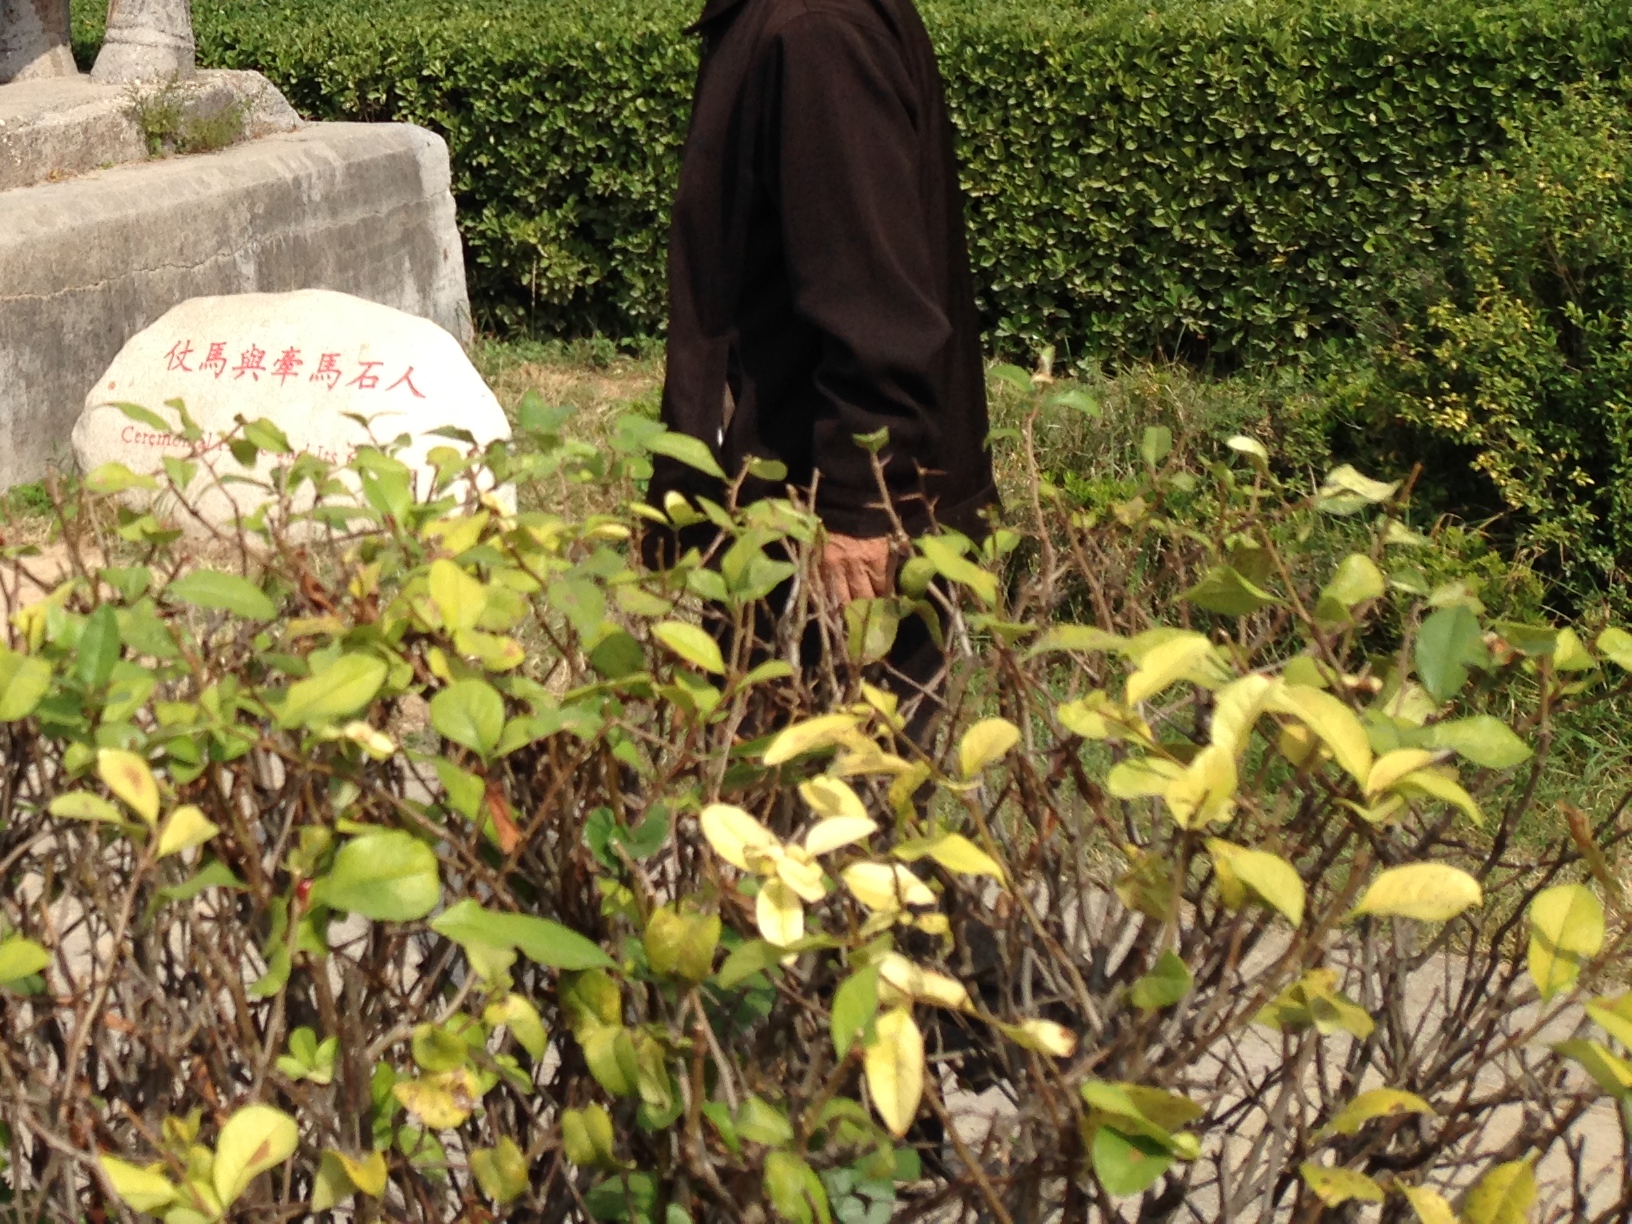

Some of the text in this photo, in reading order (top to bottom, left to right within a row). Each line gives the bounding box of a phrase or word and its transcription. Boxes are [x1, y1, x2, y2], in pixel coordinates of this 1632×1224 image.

[164, 339, 427, 399] 仗馬與牽馬石人
